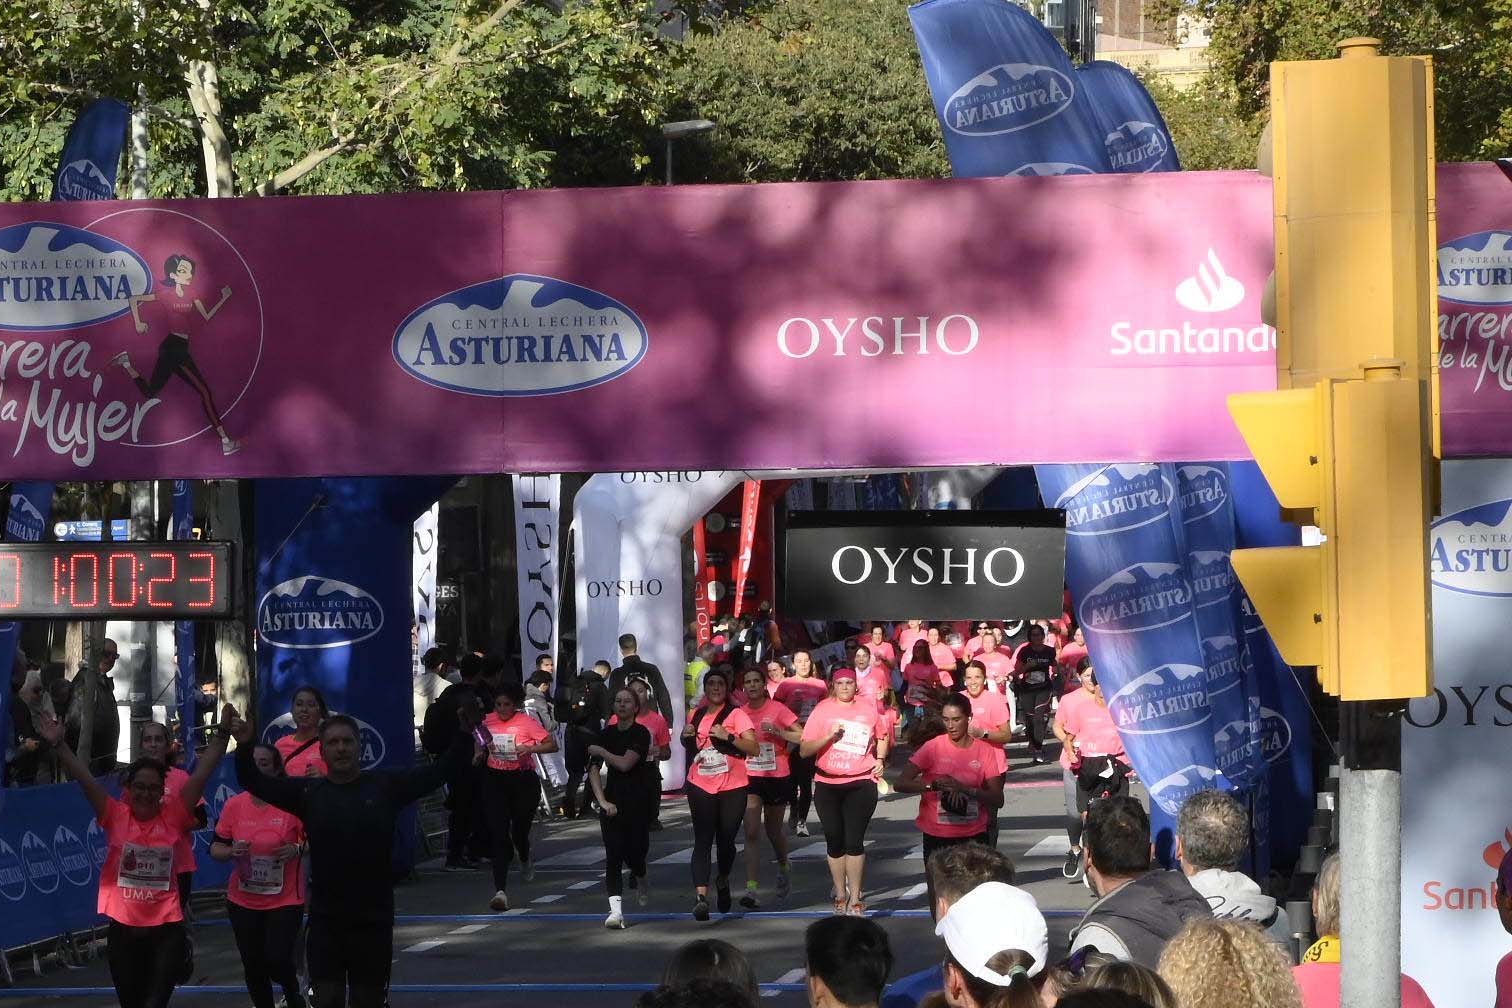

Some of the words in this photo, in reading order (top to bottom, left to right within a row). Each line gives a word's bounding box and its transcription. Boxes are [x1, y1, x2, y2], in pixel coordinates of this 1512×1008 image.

[55, 257, 128, 270] LECHERA
[451, 316, 531, 330] CENTRAL
[537, 314, 621, 328] LECHERA
[412, 321, 629, 368] ASTURIANA
[776, 313, 980, 359] OYSHO
[11, 369, 164, 468] Mujer
[831, 545, 1026, 587] OYSHO
[587, 578, 663, 599] OYSHO
[261, 605, 375, 632] ASTURIANA
[123, 887, 154, 900] UMA
